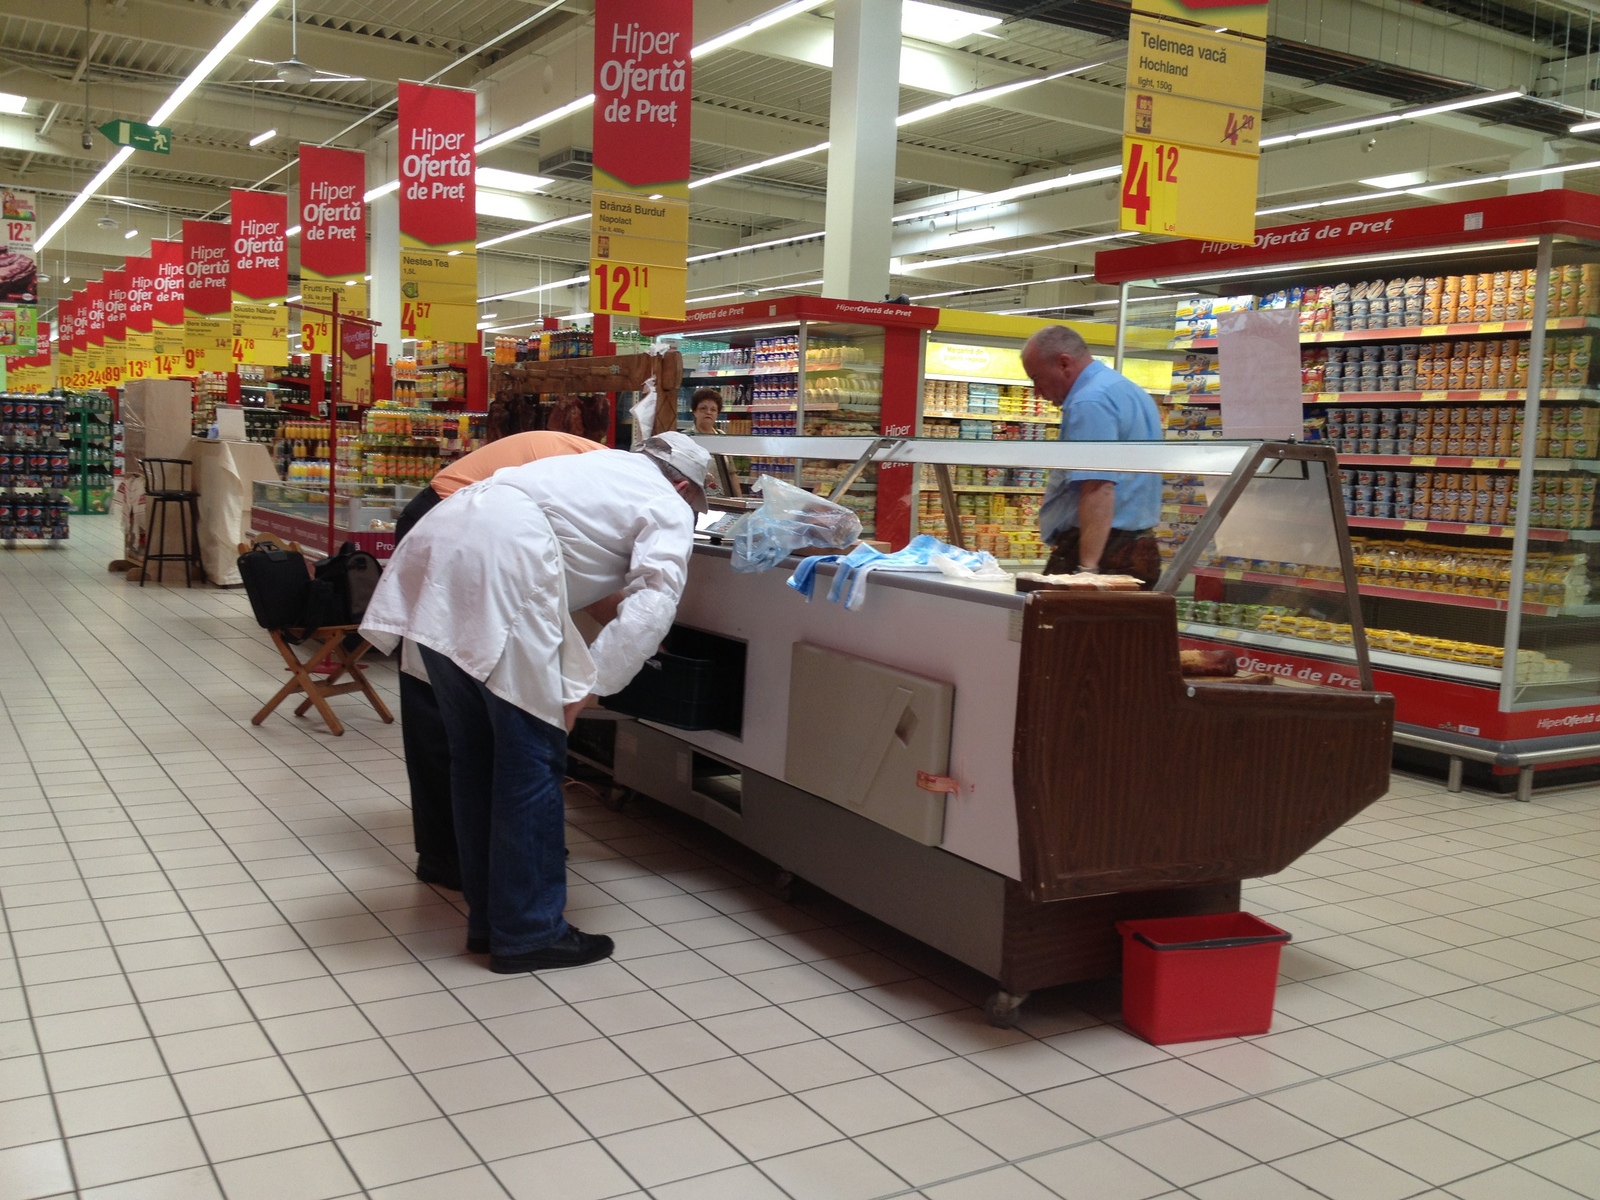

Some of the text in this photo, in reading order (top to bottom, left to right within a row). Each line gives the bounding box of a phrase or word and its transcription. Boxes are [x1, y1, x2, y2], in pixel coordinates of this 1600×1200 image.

[611, 22, 679, 62] Hiper
[1141, 31, 1227, 64] Telemea vacă
[1139, 56, 1188, 77] Hochland
[600, 59, 686, 100] Ofertă
[1138, 76, 1173, 92] light, 150g
[604, 98, 678, 127] de Preț
[1224, 112, 1239, 146] 4
[411, 127, 465, 155] Hiper
[403, 153, 471, 183] Ofertă
[310, 181, 356, 204] Hiper
[407, 182, 465, 202] de Preț
[1122, 143, 1179, 225] 4 12
[303, 201, 361, 228] Ofertă
[600, 200, 666, 217] Brânză Burduf
[240, 219, 280, 239] Hiper
[599, 214, 632, 225] Napolact
[1164, 222, 1176, 232] Lei
[1315, 225, 1341, 239] de
[1348, 218, 1394, 236] Preț
[7, 222, 24, 241] 12
[307, 225, 356, 243] de Preț
[190, 245, 226, 264] Hiper
[234, 236, 284, 259] Ofertă
[186, 259, 230, 281] Ofertă
[237, 256, 280, 270] de Preț
[403, 255, 450, 269] Nestea Tea
[132, 277, 153, 289] Hip
[188, 277, 226, 289] de Preț
[303, 284, 345, 294] Frutti Fresh
[594, 264, 648, 313] 12 11
[156, 292, 169, 302] de
[130, 303, 142, 312] de
[234, 305, 255, 313] Giusto
[717, 309, 727, 318] de
[728, 307, 745, 316] Preț
[836, 303, 912, 318] HiperOfertă de Preț
[90, 321, 101, 329] de
[107, 313, 118, 322] de
[401, 302, 431, 337] 4 57
[302, 323, 328, 351] 3 79
[185, 349, 195, 369] 9
[232, 338, 255, 362] 4 78
[105, 366, 120, 382] 89
[128, 360, 143, 377] 13
[155, 356, 180, 375] 14 57
[73, 373, 86, 387] 23
[885, 424, 911, 436] Hiper
[1236, 656, 1293, 676] Ofertă
[1297, 667, 1323, 681] de
[1536, 713, 1595, 730] HiperOfertă
